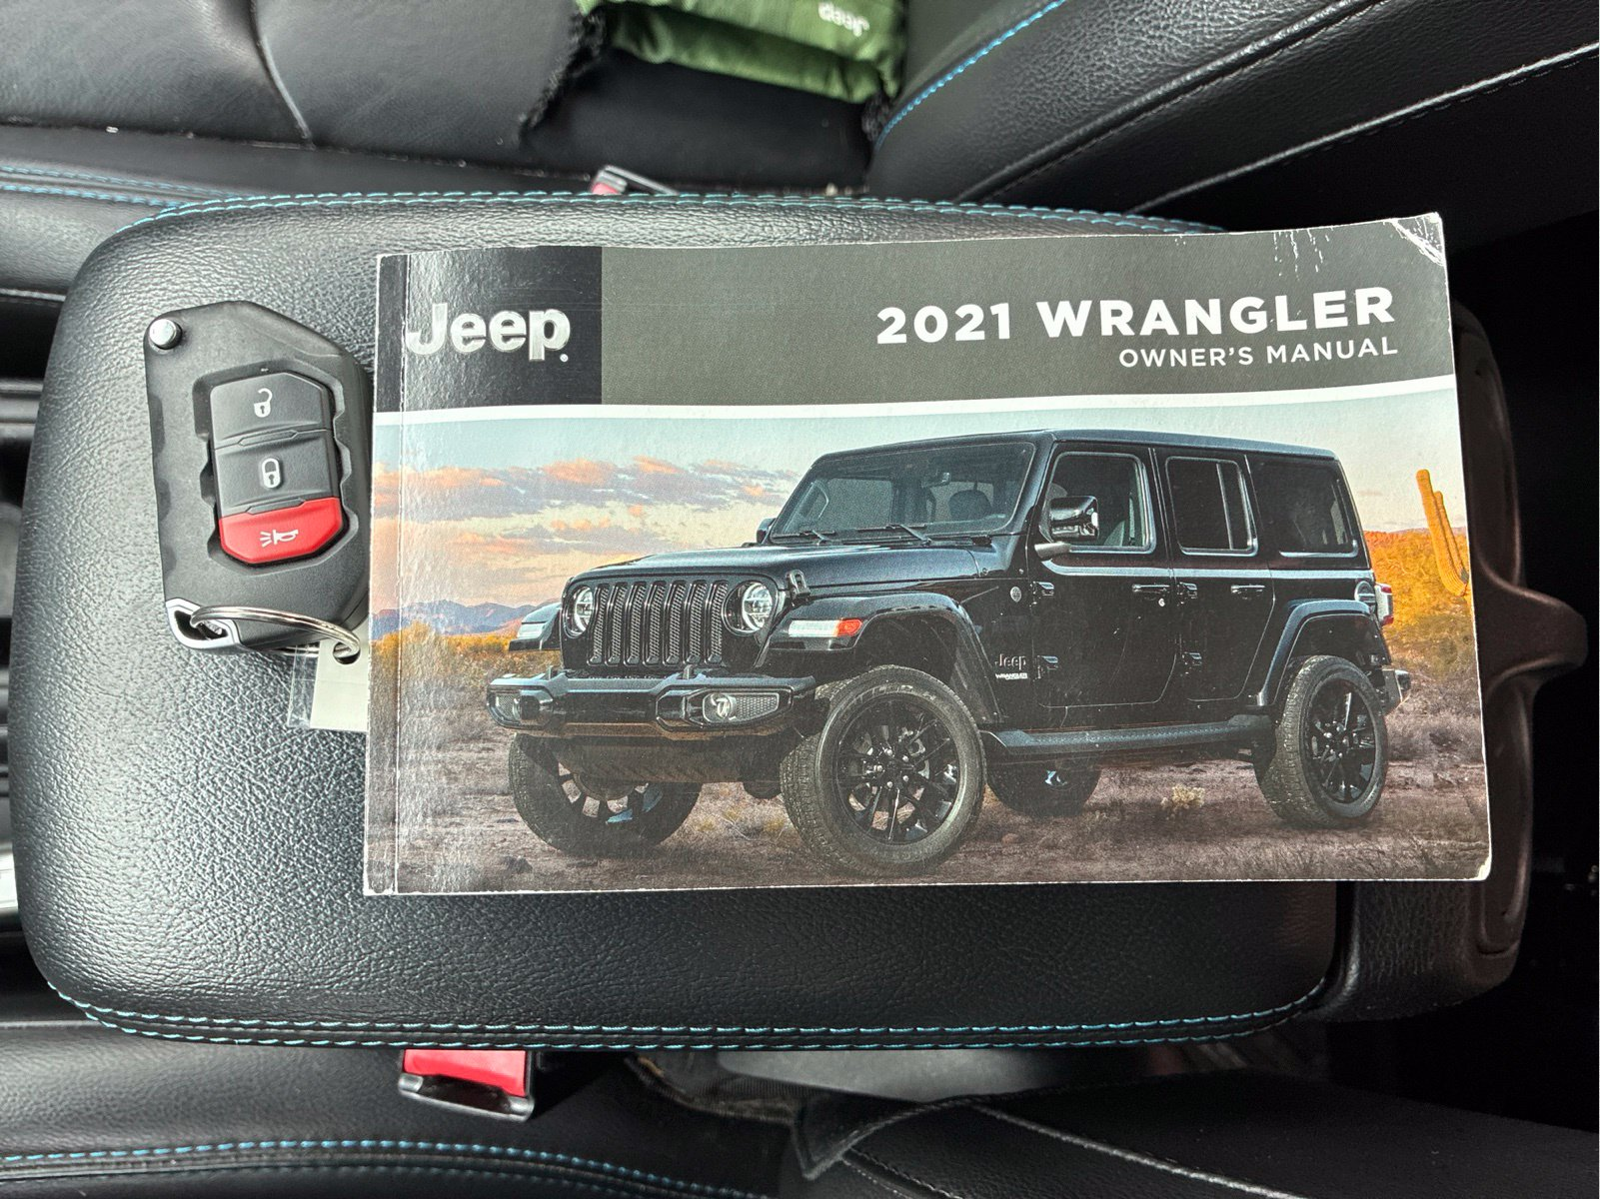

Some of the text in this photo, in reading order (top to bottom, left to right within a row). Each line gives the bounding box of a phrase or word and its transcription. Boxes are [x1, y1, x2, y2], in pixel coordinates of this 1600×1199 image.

[818, 2, 870, 37] Jeep
[876, 286, 1395, 345] 2021 WRANGLER
[1118, 336, 1398, 368] OWNER'S MANUAL
[995, 653, 1027, 671] Jeep
